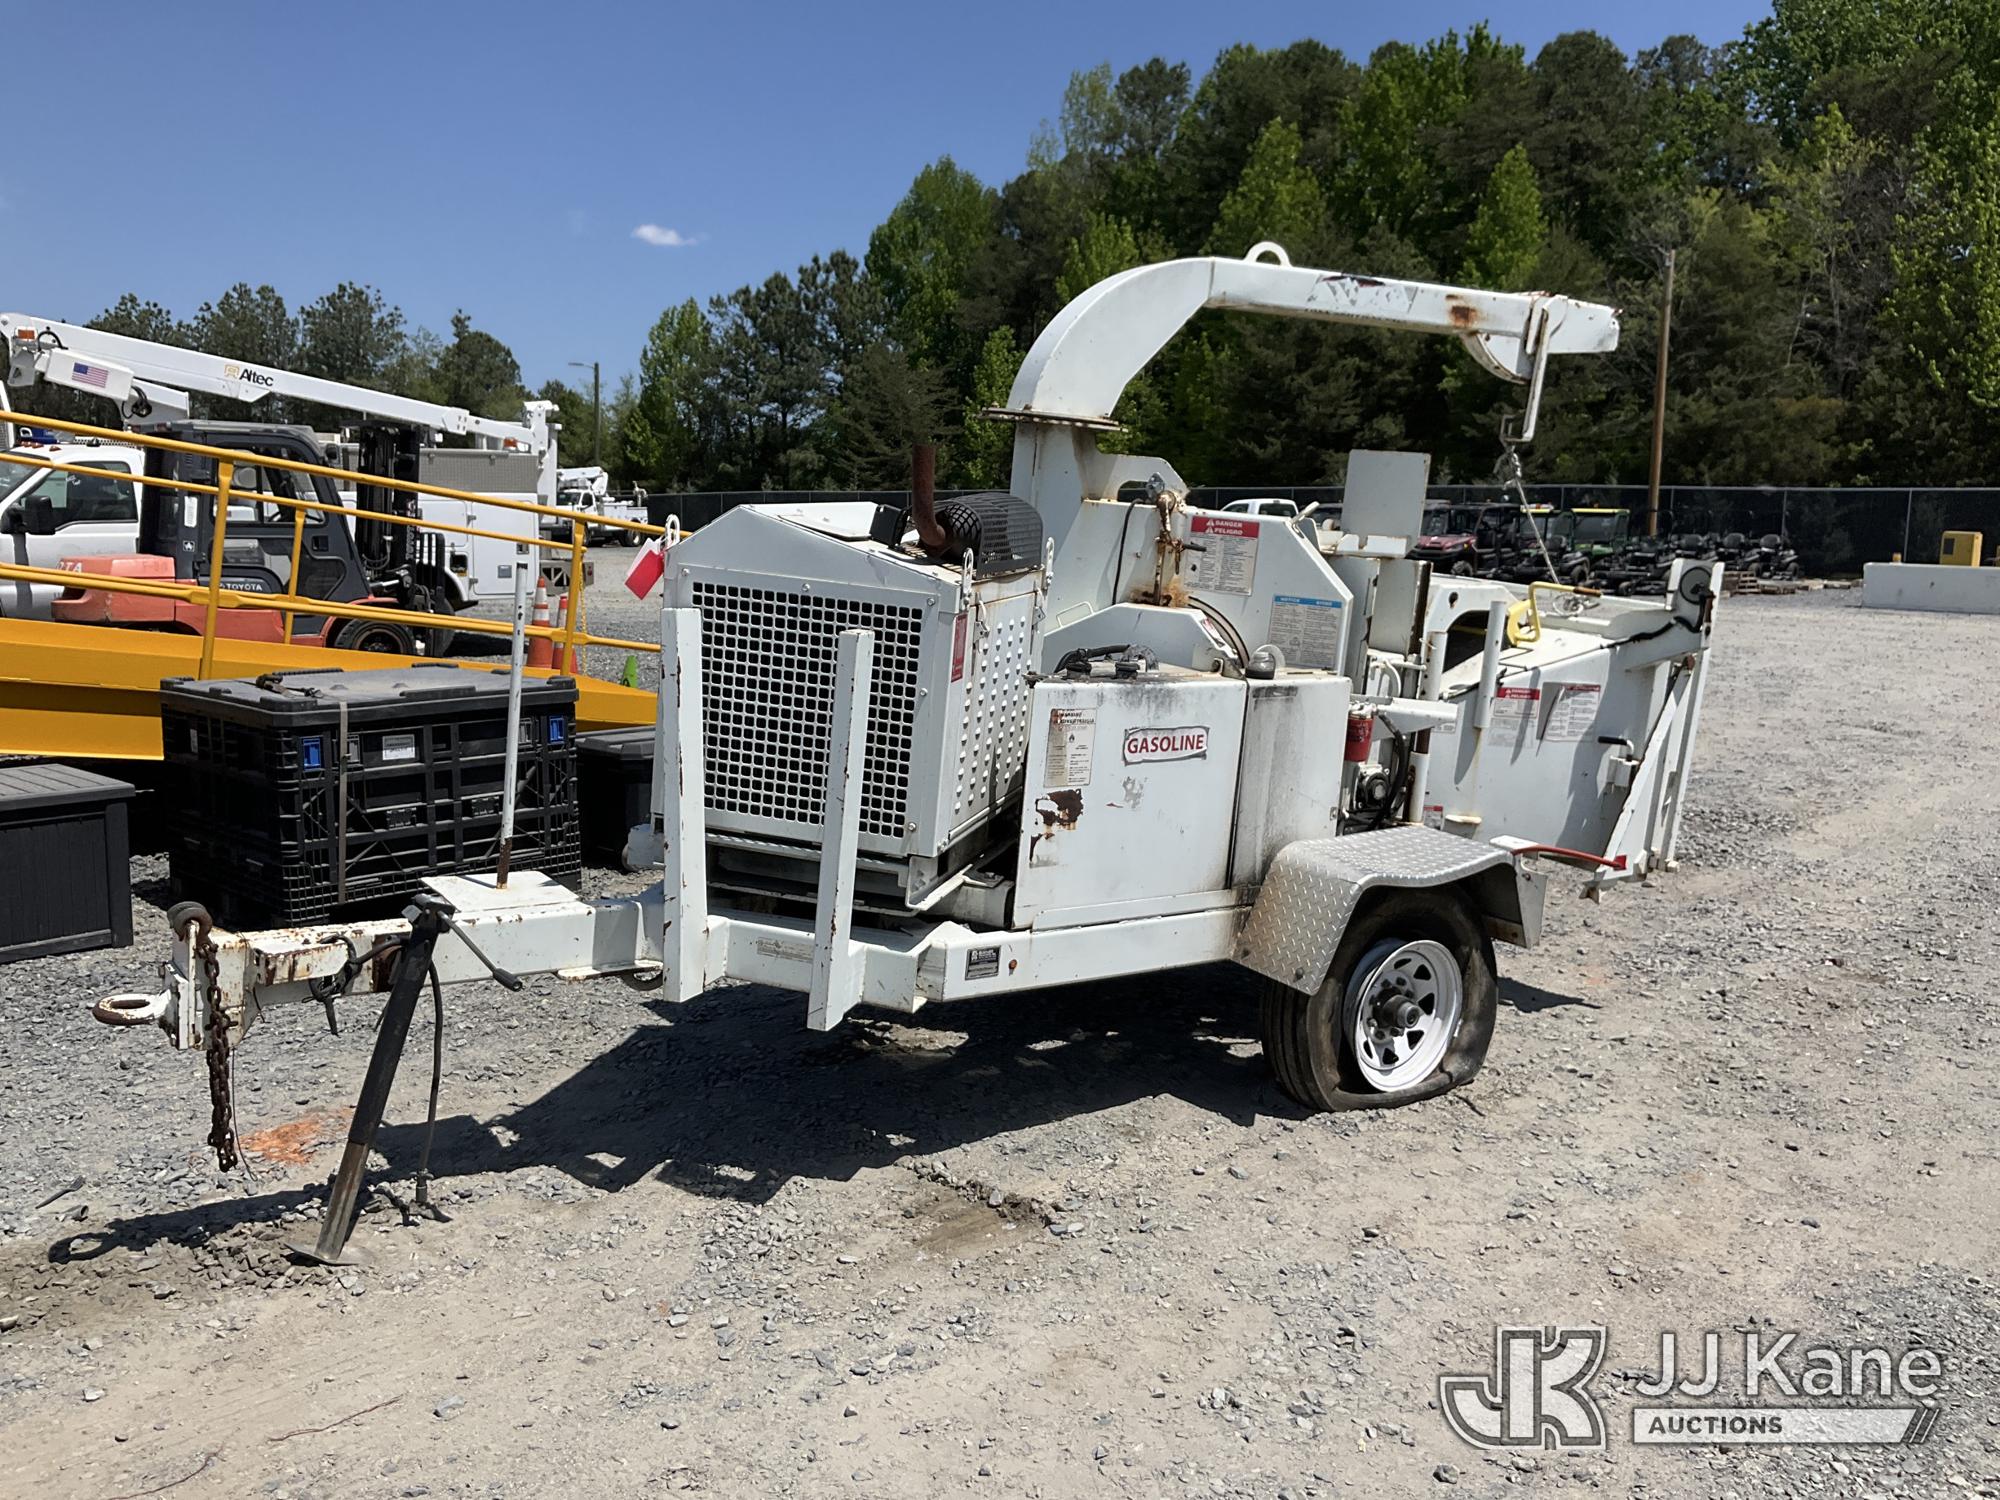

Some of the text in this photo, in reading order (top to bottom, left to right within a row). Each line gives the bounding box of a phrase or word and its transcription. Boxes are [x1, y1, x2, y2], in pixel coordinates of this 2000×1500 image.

[239, 368, 274, 387] Altec
[1215, 520, 1243, 528] DANGER
[1214, 527, 1243, 535] PELIGRO
[226, 583, 263, 592] TOYOTA
[1127, 734, 1205, 754] GASOLINE
